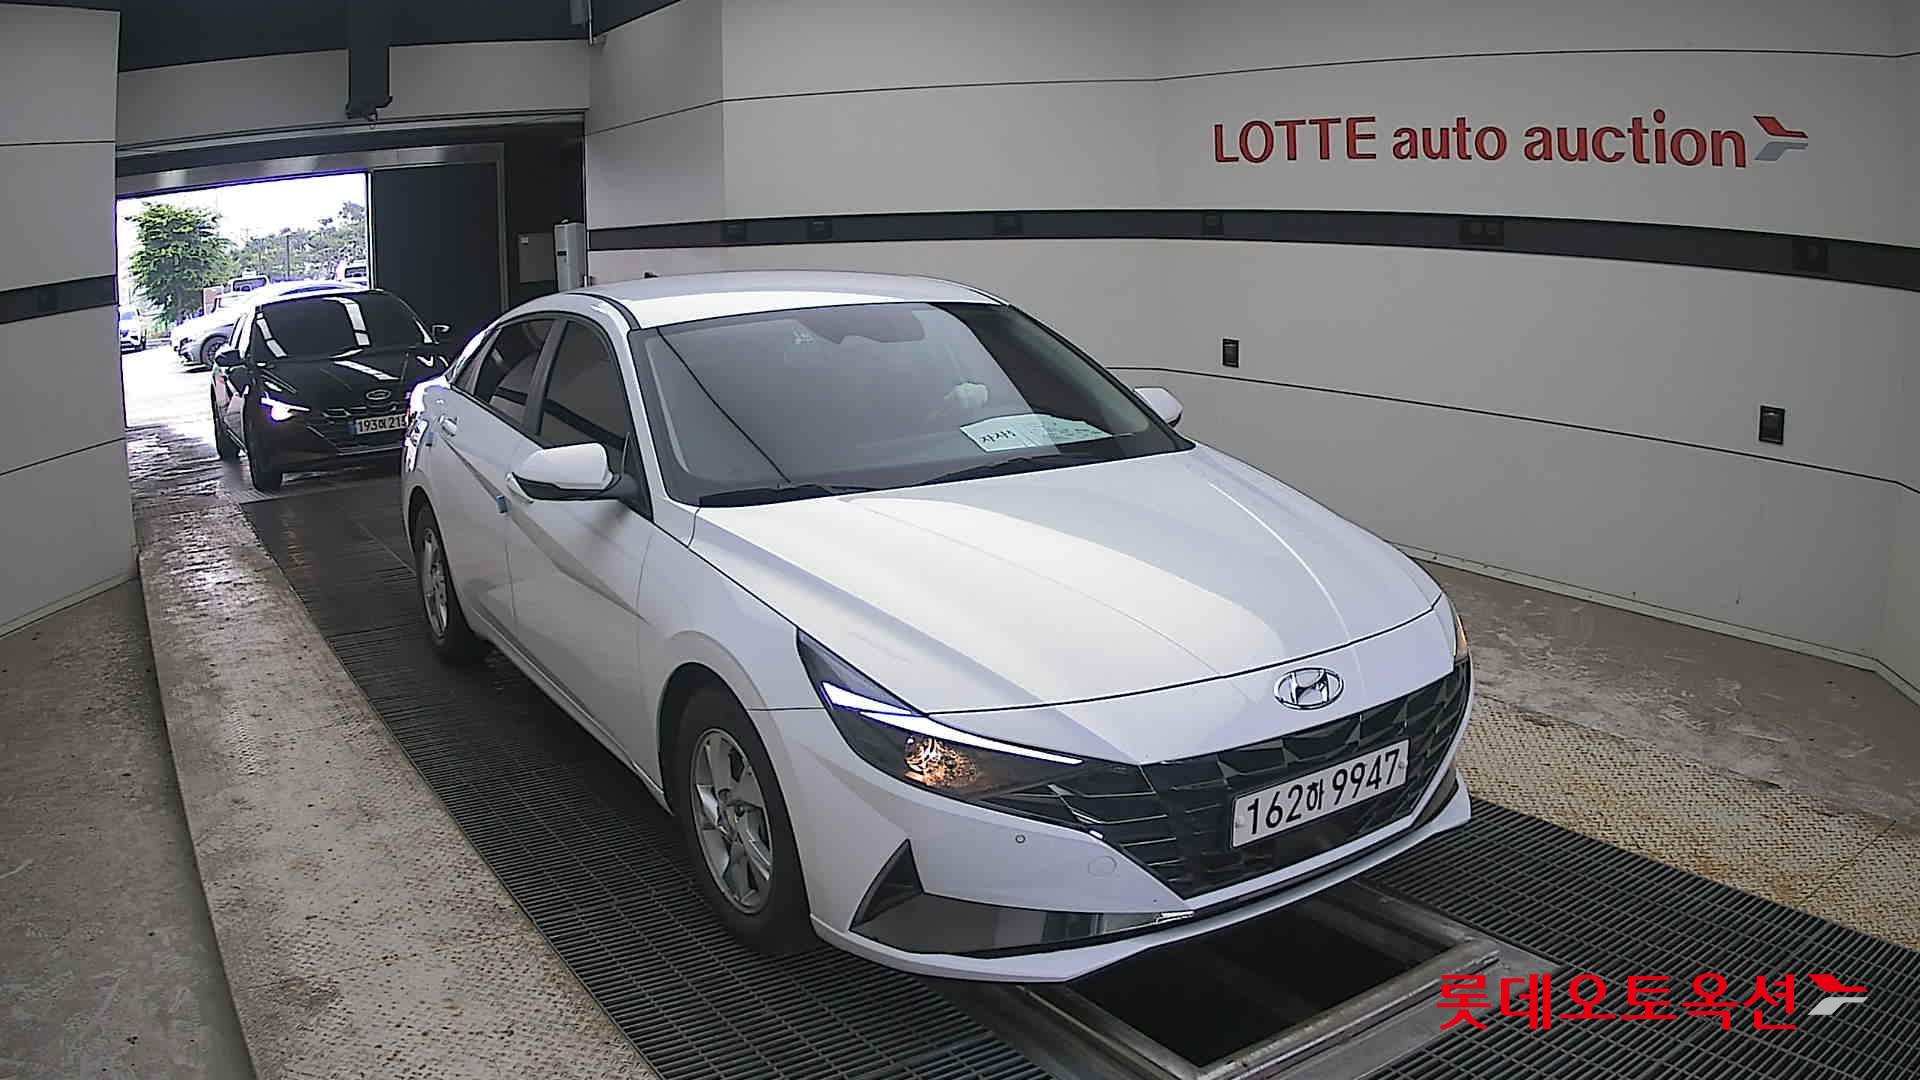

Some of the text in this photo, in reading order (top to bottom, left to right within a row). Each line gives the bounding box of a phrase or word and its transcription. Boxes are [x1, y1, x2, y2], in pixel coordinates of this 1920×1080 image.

[1213, 108, 1747, 168] LOTTE auto auction
[1247, 748, 1401, 835] 162하 9947
